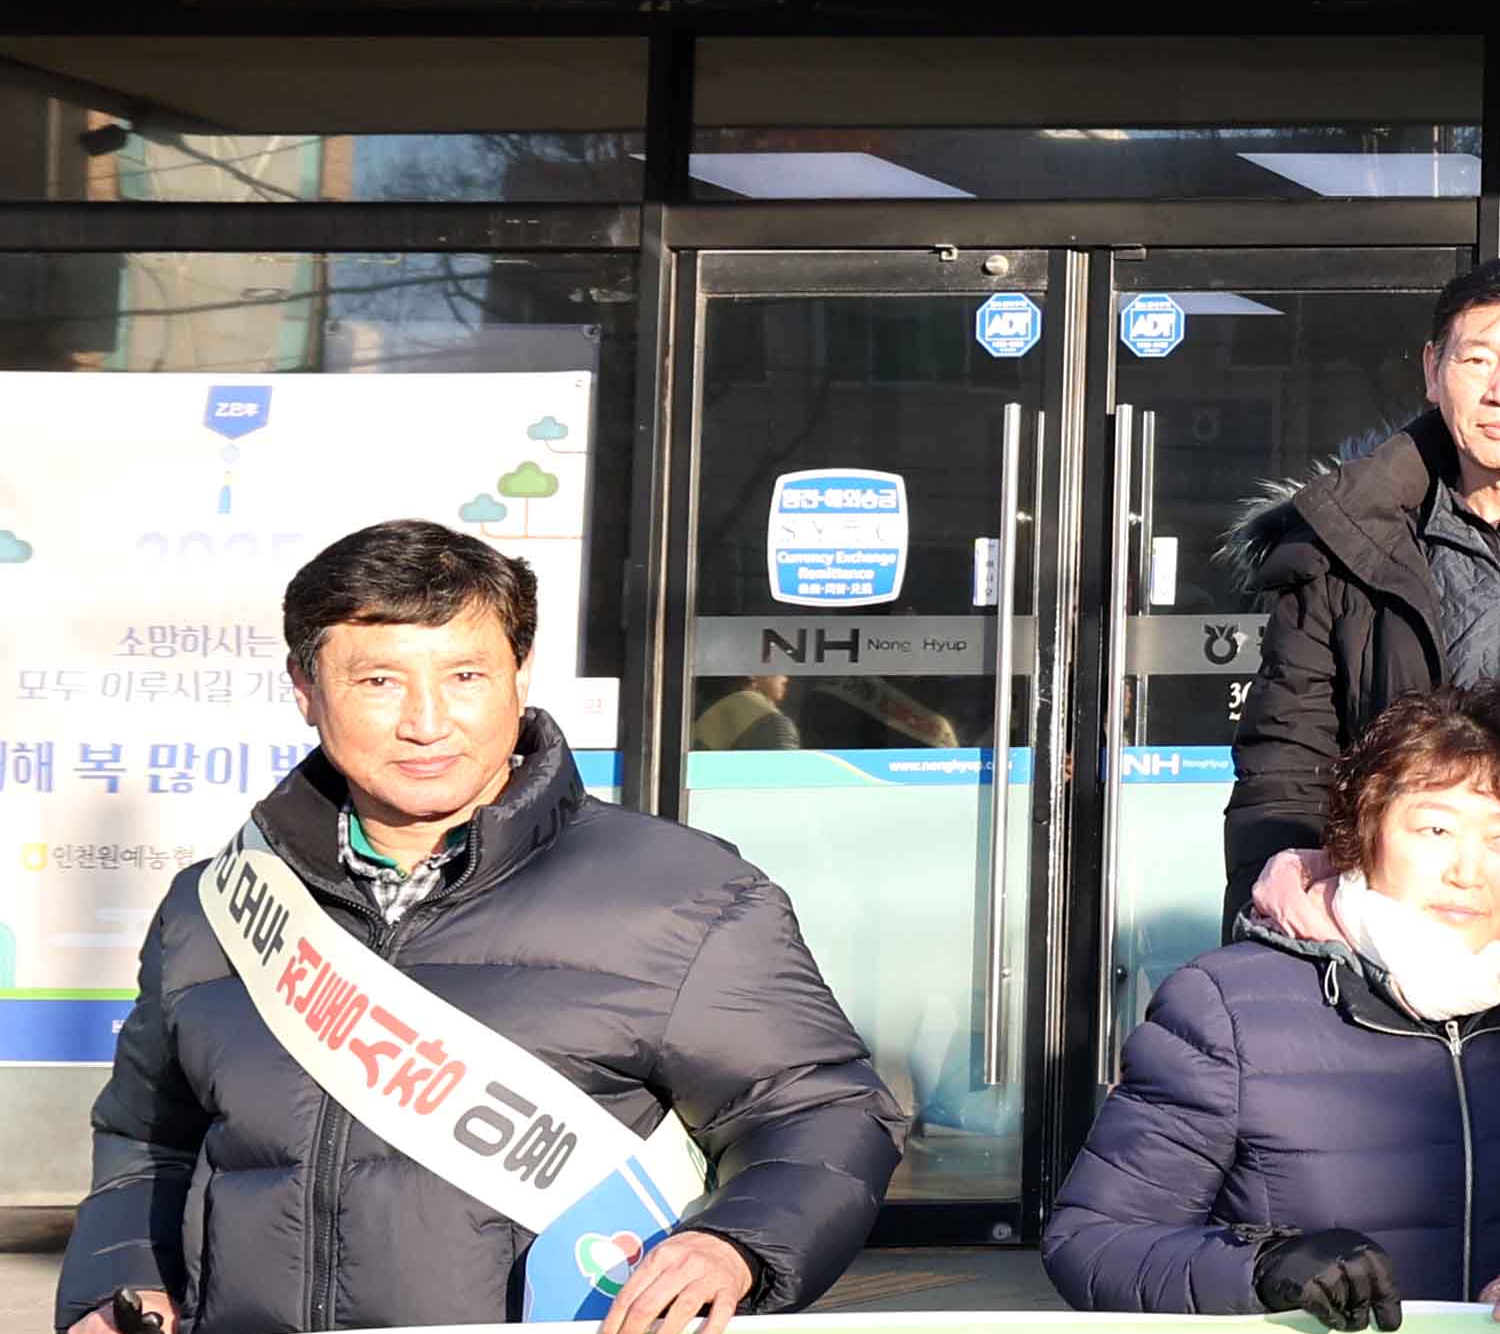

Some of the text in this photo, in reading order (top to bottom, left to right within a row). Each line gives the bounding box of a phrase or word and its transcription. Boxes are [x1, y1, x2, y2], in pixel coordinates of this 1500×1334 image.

[988, 313, 1031, 336] ADT
[1131, 313, 1176, 337] ADT
[116, 625, 280, 660] 소망하시는
[762, 628, 968, 663] NH Nong Hyup
[17, 670, 85, 703] 모두
[101, 670, 233, 704] 이루시길
[0, 740, 56, 795] 해
[73, 740, 128, 795] 복
[147, 740, 250, 795] 많이
[1123, 752, 1180, 776] NH
[230, 863, 290, 966] 모두
[276, 937, 467, 1116] 전통시장
[453, 1081, 578, 1190] 이용
